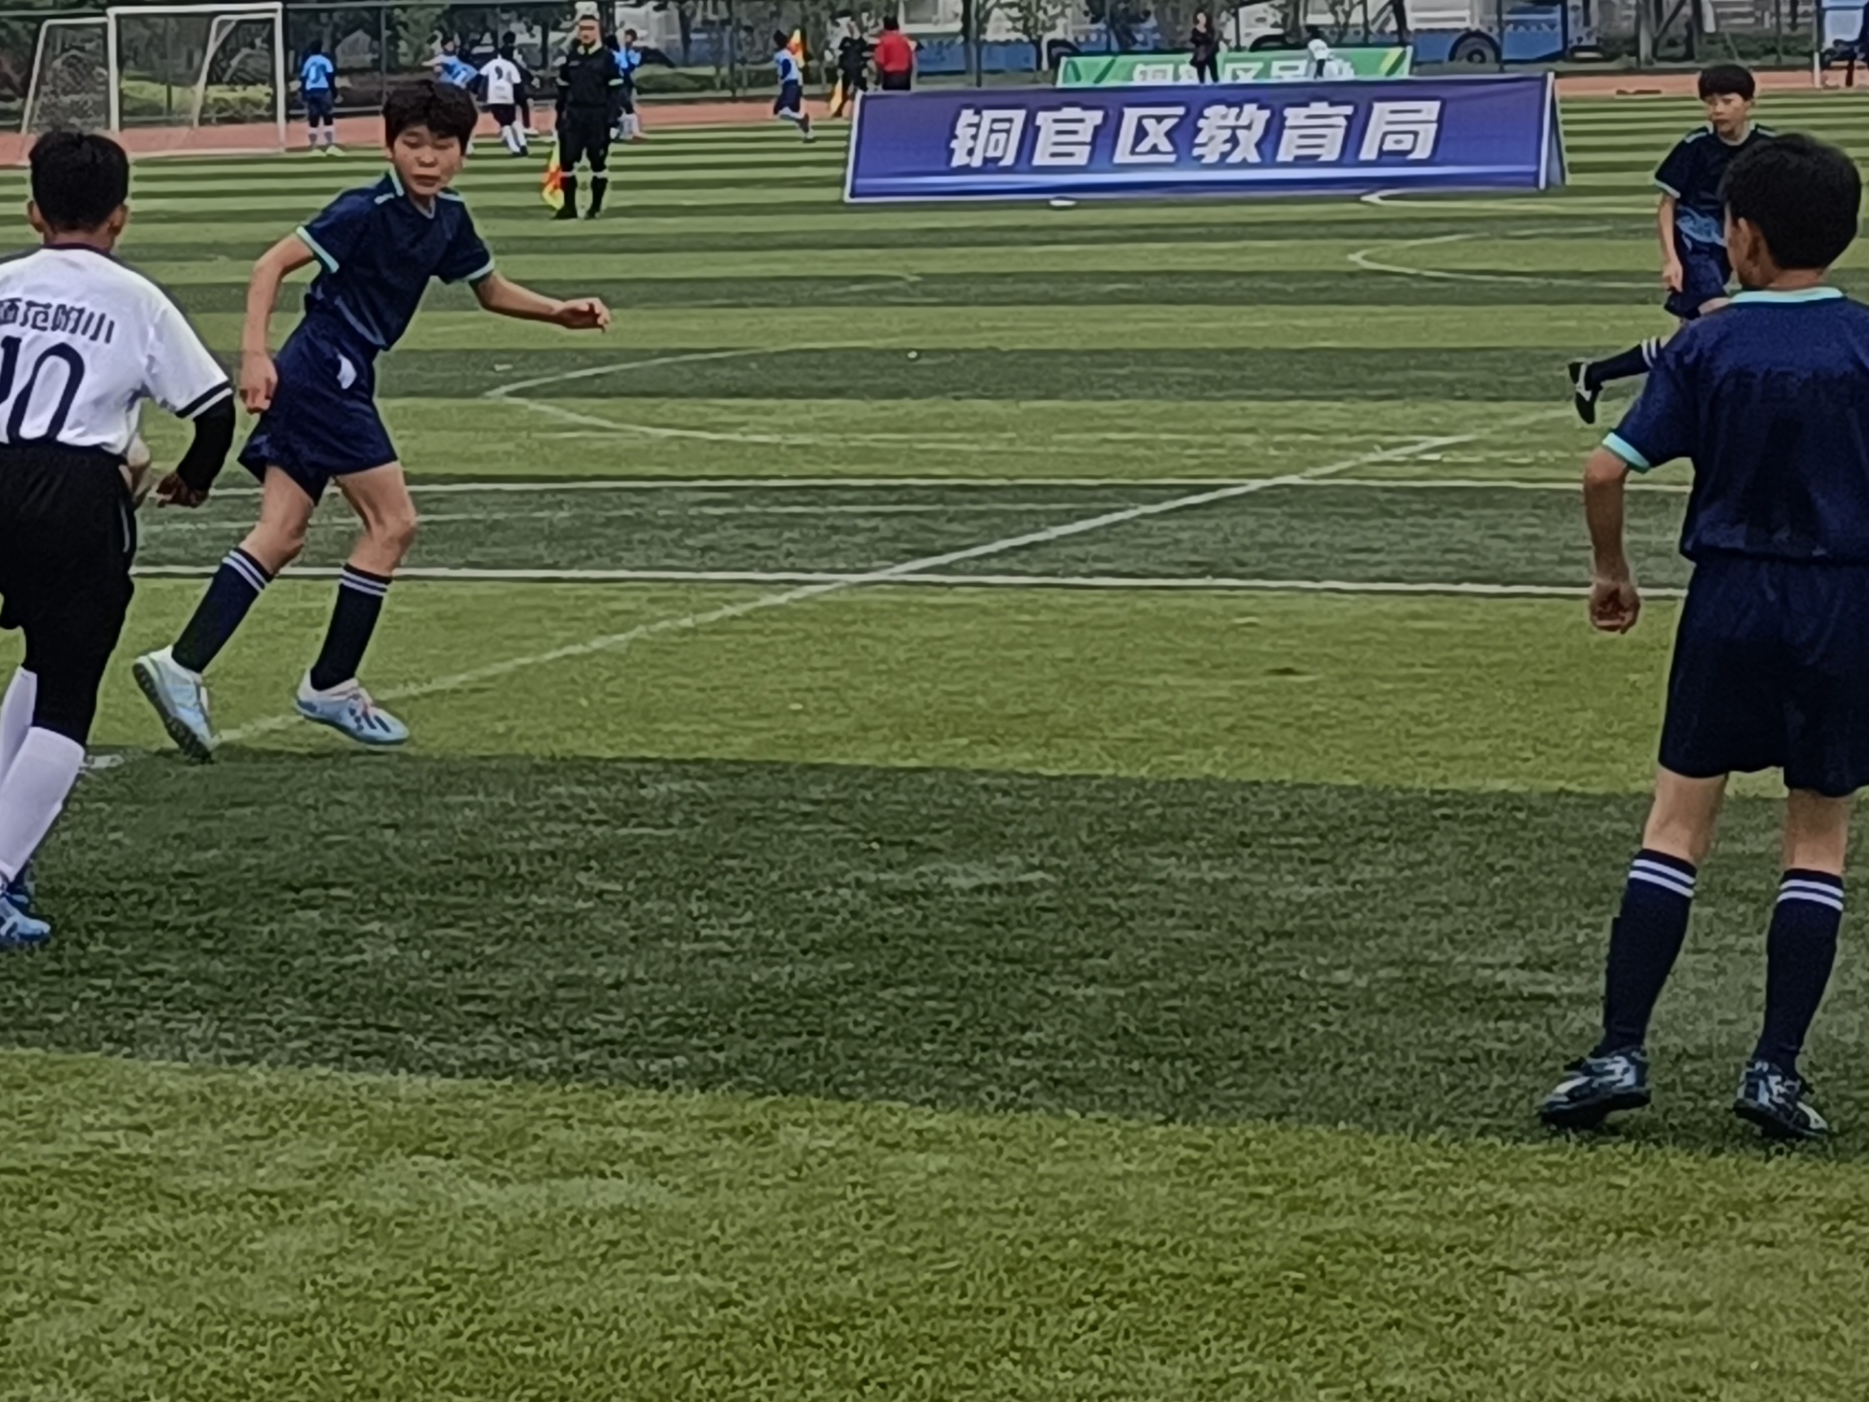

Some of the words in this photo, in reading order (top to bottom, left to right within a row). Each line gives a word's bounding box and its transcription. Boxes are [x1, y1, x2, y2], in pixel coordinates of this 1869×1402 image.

[949, 100, 1442, 168] 铜官区教育局
